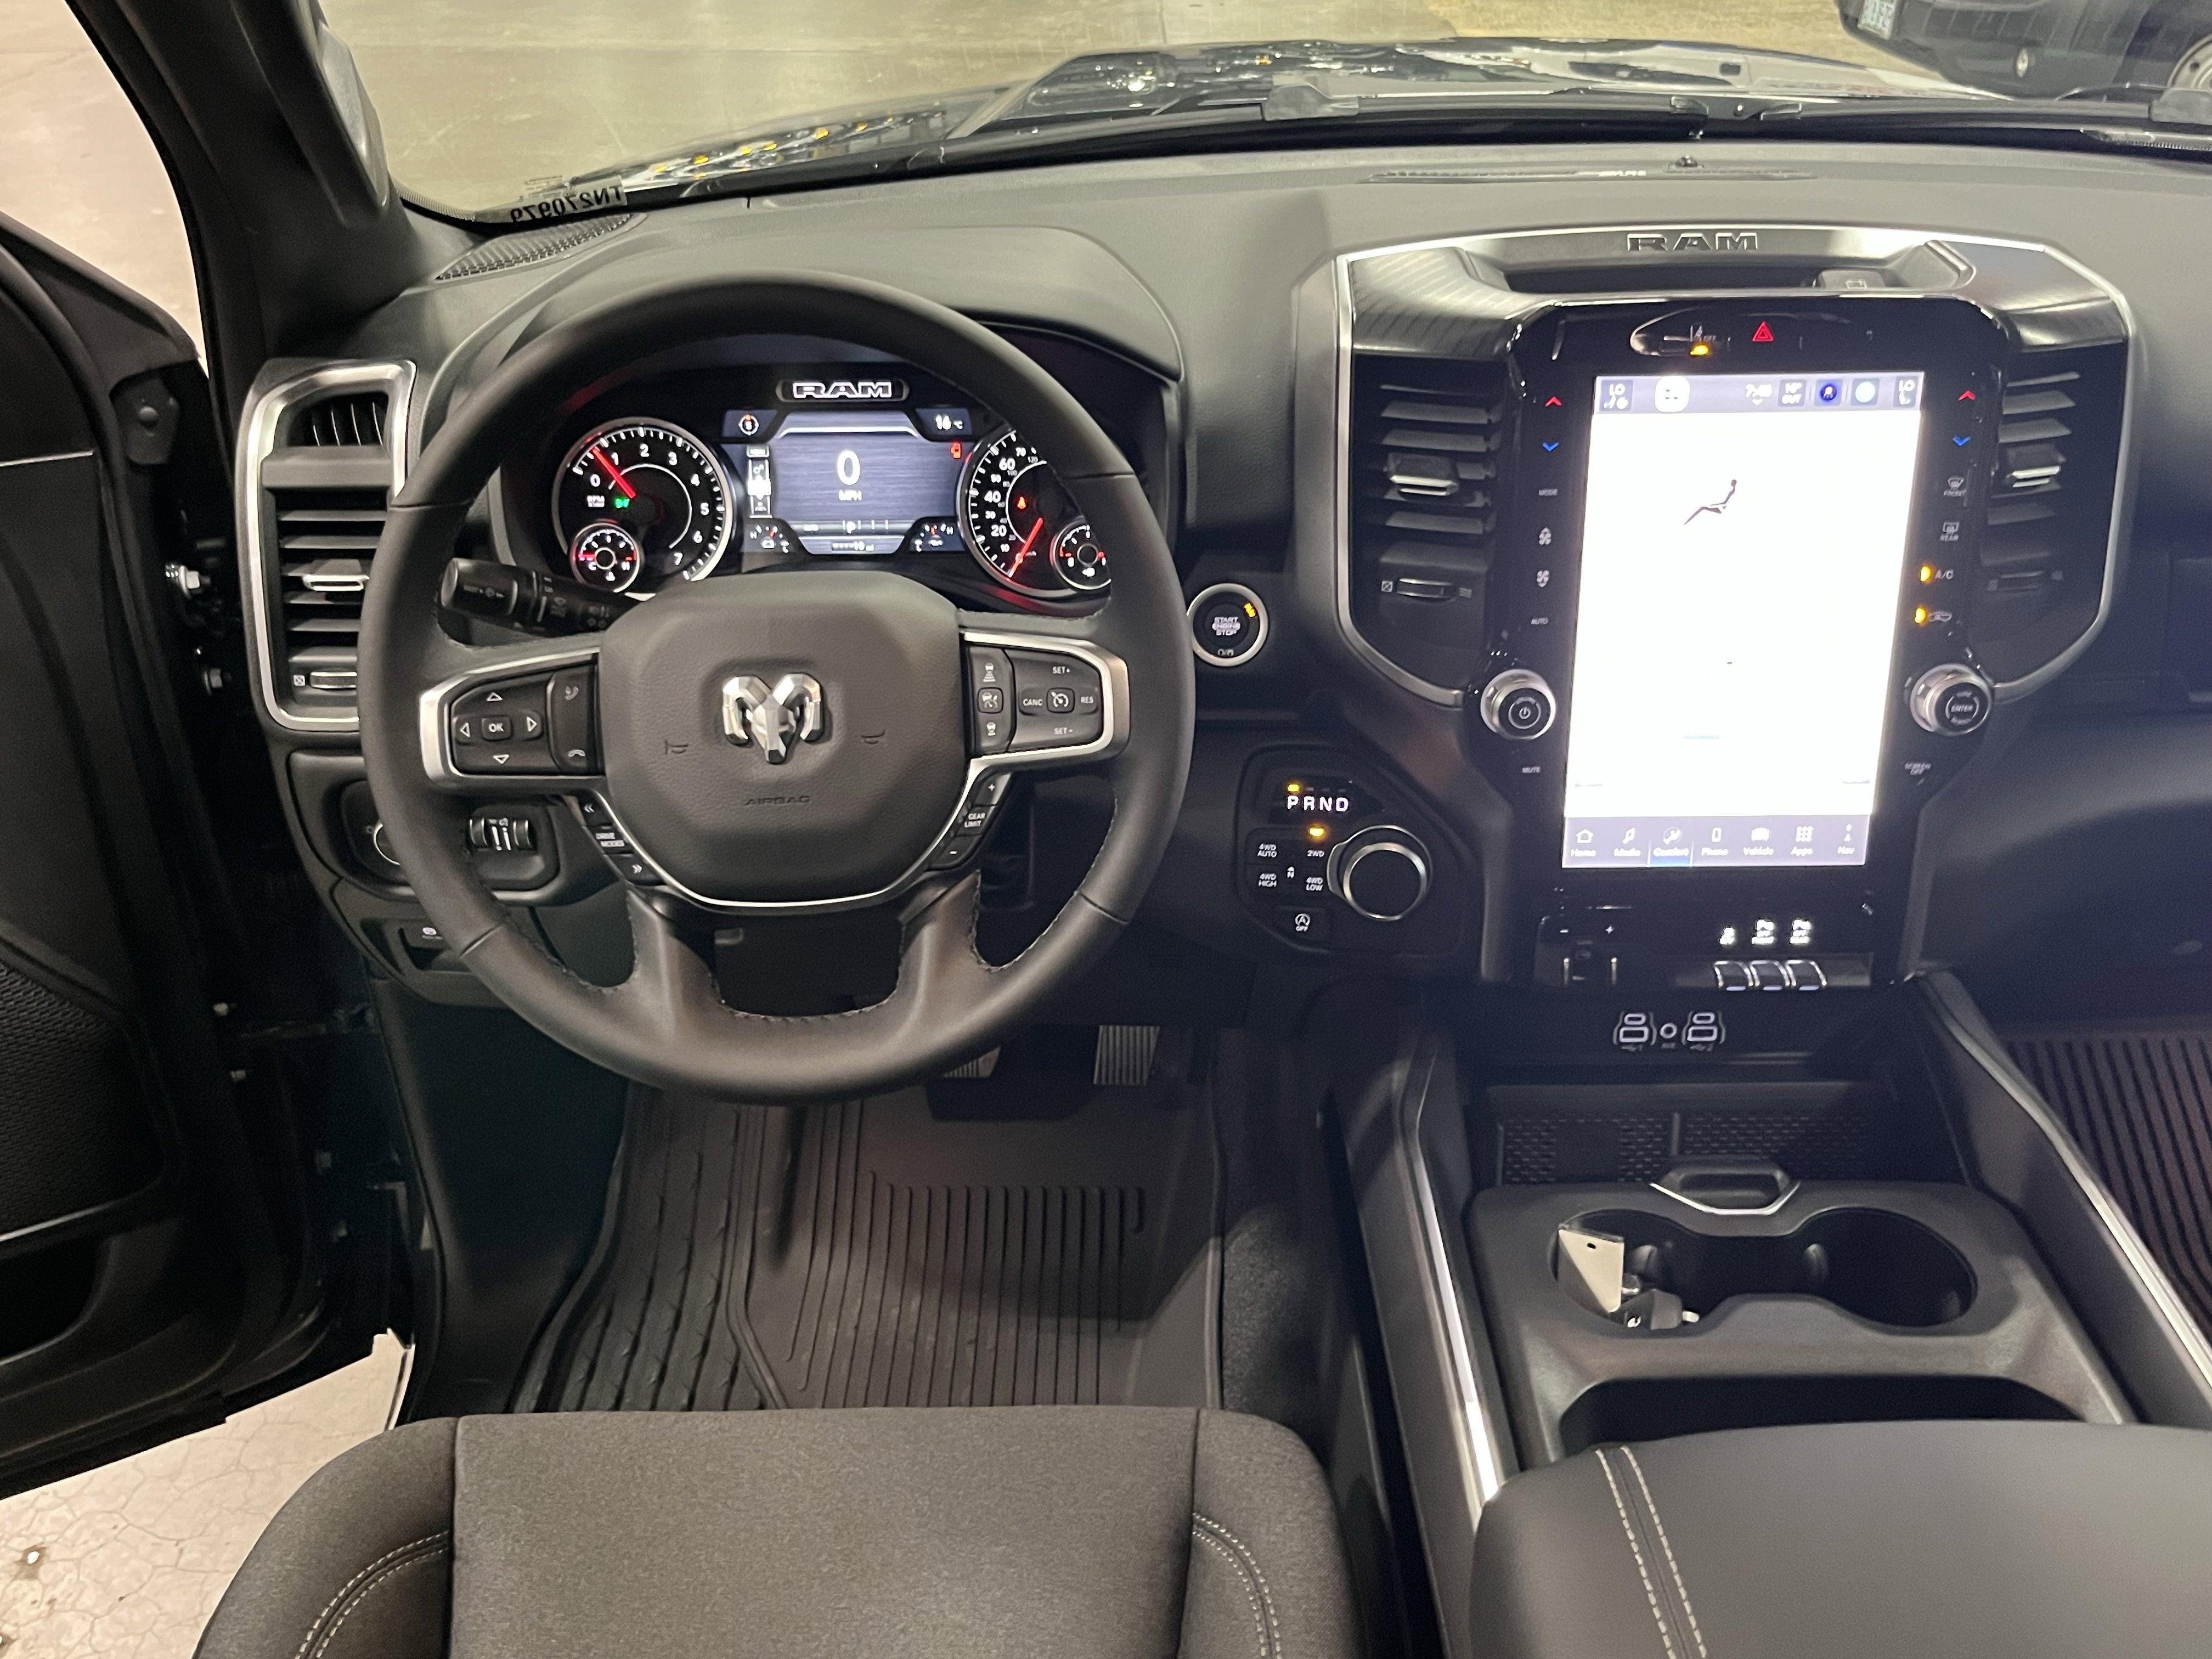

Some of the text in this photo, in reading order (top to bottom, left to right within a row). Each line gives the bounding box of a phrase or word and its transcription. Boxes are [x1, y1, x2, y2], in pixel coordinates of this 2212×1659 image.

[1627, 233, 1758, 251] RAM
[793, 382, 892, 398] RAM
[640, 444, 650, 457] 2
[1015, 447, 1026, 456] 70
[611, 453, 619, 465] 1
[668, 452, 678, 466] 3
[999, 458, 1015, 470] 60
[837, 450, 860, 486] 0
[590, 474, 601, 487] 0
[691, 473, 700, 486] 4
[984, 490, 1001, 503] 40
[701, 503, 709, 516] 5
[991, 524, 1007, 537] 20
[693, 531, 703, 544] 6
[674, 552, 683, 566] 7
[1935, 569, 1954, 579] A/C
[488, 723, 504, 732] OK
[743, 795, 811, 806] AIRBAG
